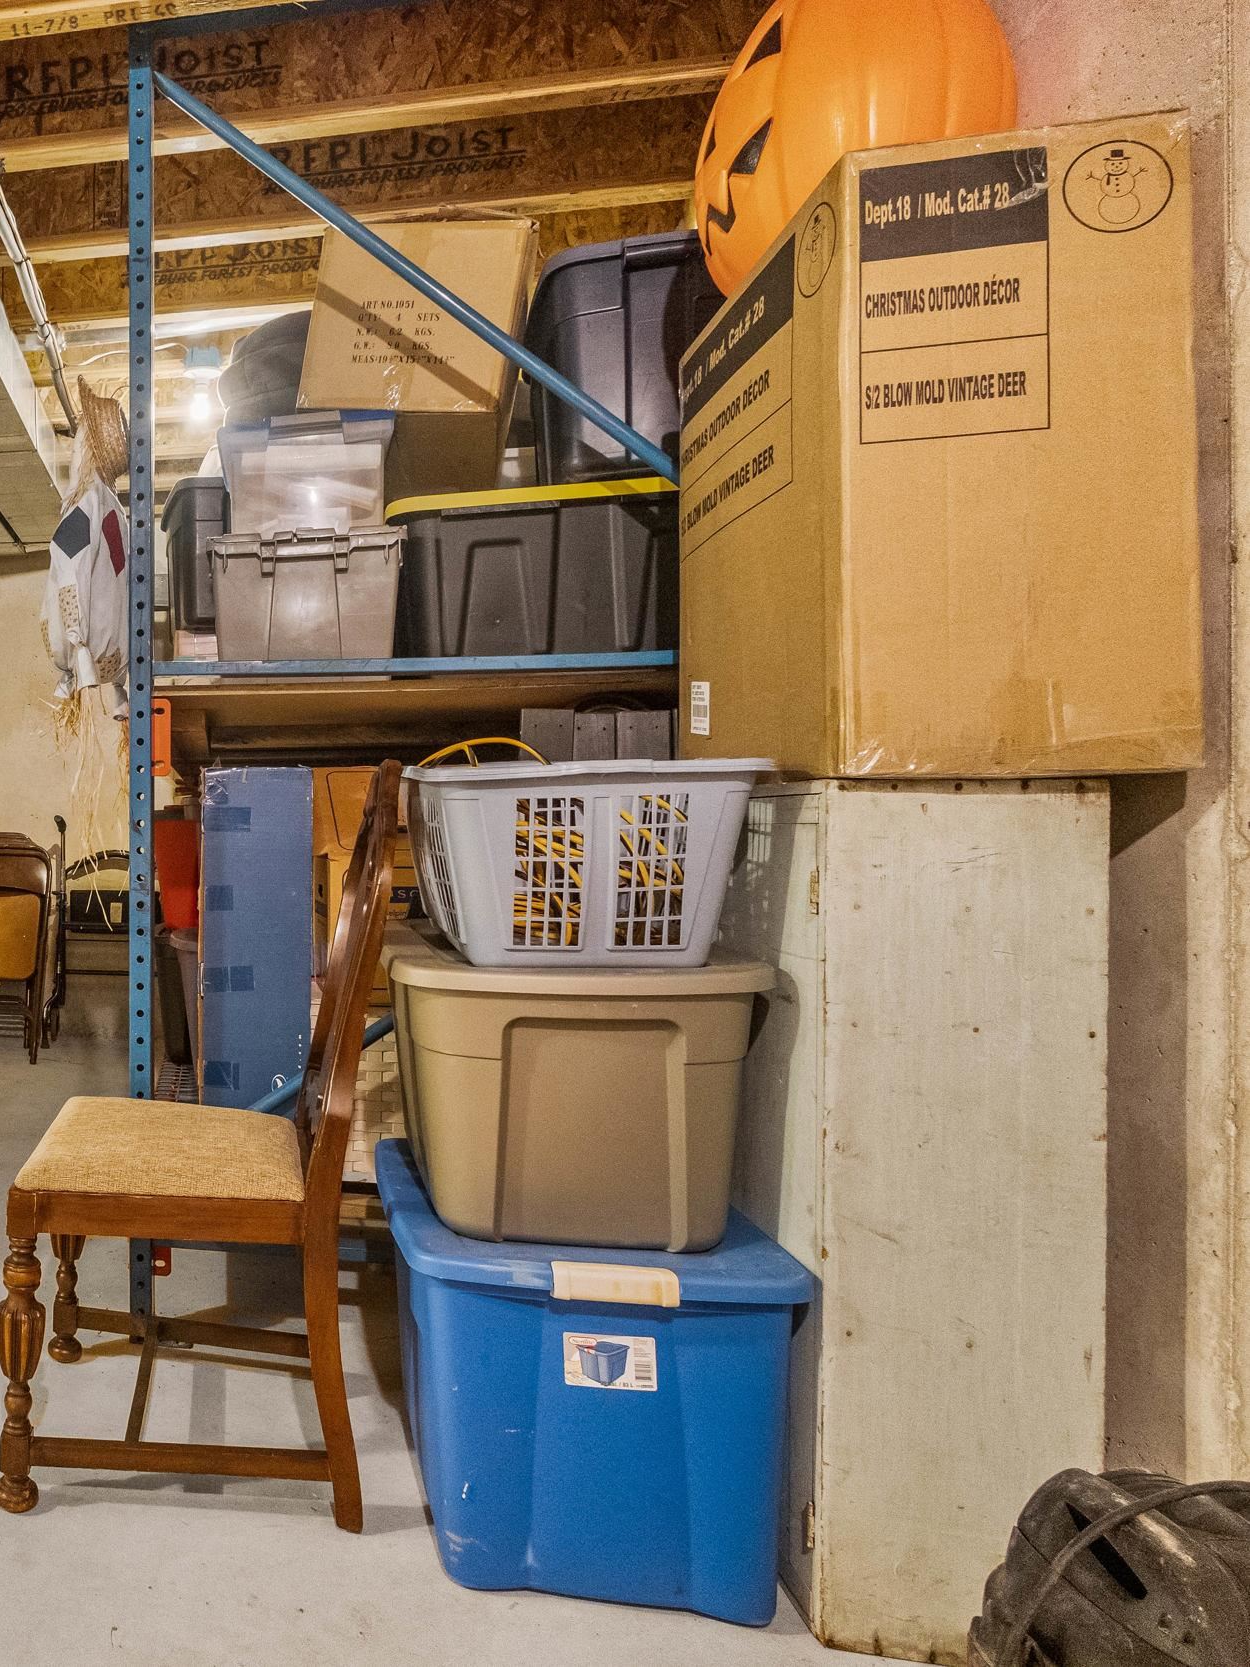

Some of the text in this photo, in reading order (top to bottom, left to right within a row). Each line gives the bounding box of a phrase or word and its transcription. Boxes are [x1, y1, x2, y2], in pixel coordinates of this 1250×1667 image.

[391, 127, 515, 161] JOIST
[864, 195, 911, 229] Dept.18
[925, 190, 954, 217] Mod.
[957, 184, 991, 214] Cat.#
[993, 182, 1010, 209] 28
[416, 312, 440, 322] SETS
[865, 274, 1020, 319] CHRISTMAS OUTDOOR DÉCOR
[709, 338, 726, 373] Mod.
[752, 295, 765, 326] 28
[883, 381, 913, 408] BLOW
[915, 379, 945, 406] MOLD
[947, 373, 994, 403] VINTAGE
[998, 371, 1027, 398] DEER
[709, 396, 741, 442] OUTDOOR
[702, 488, 718, 518] MOLD
[718, 462, 751, 503] VINTAGE
[752, 444, 775, 479] DEER
